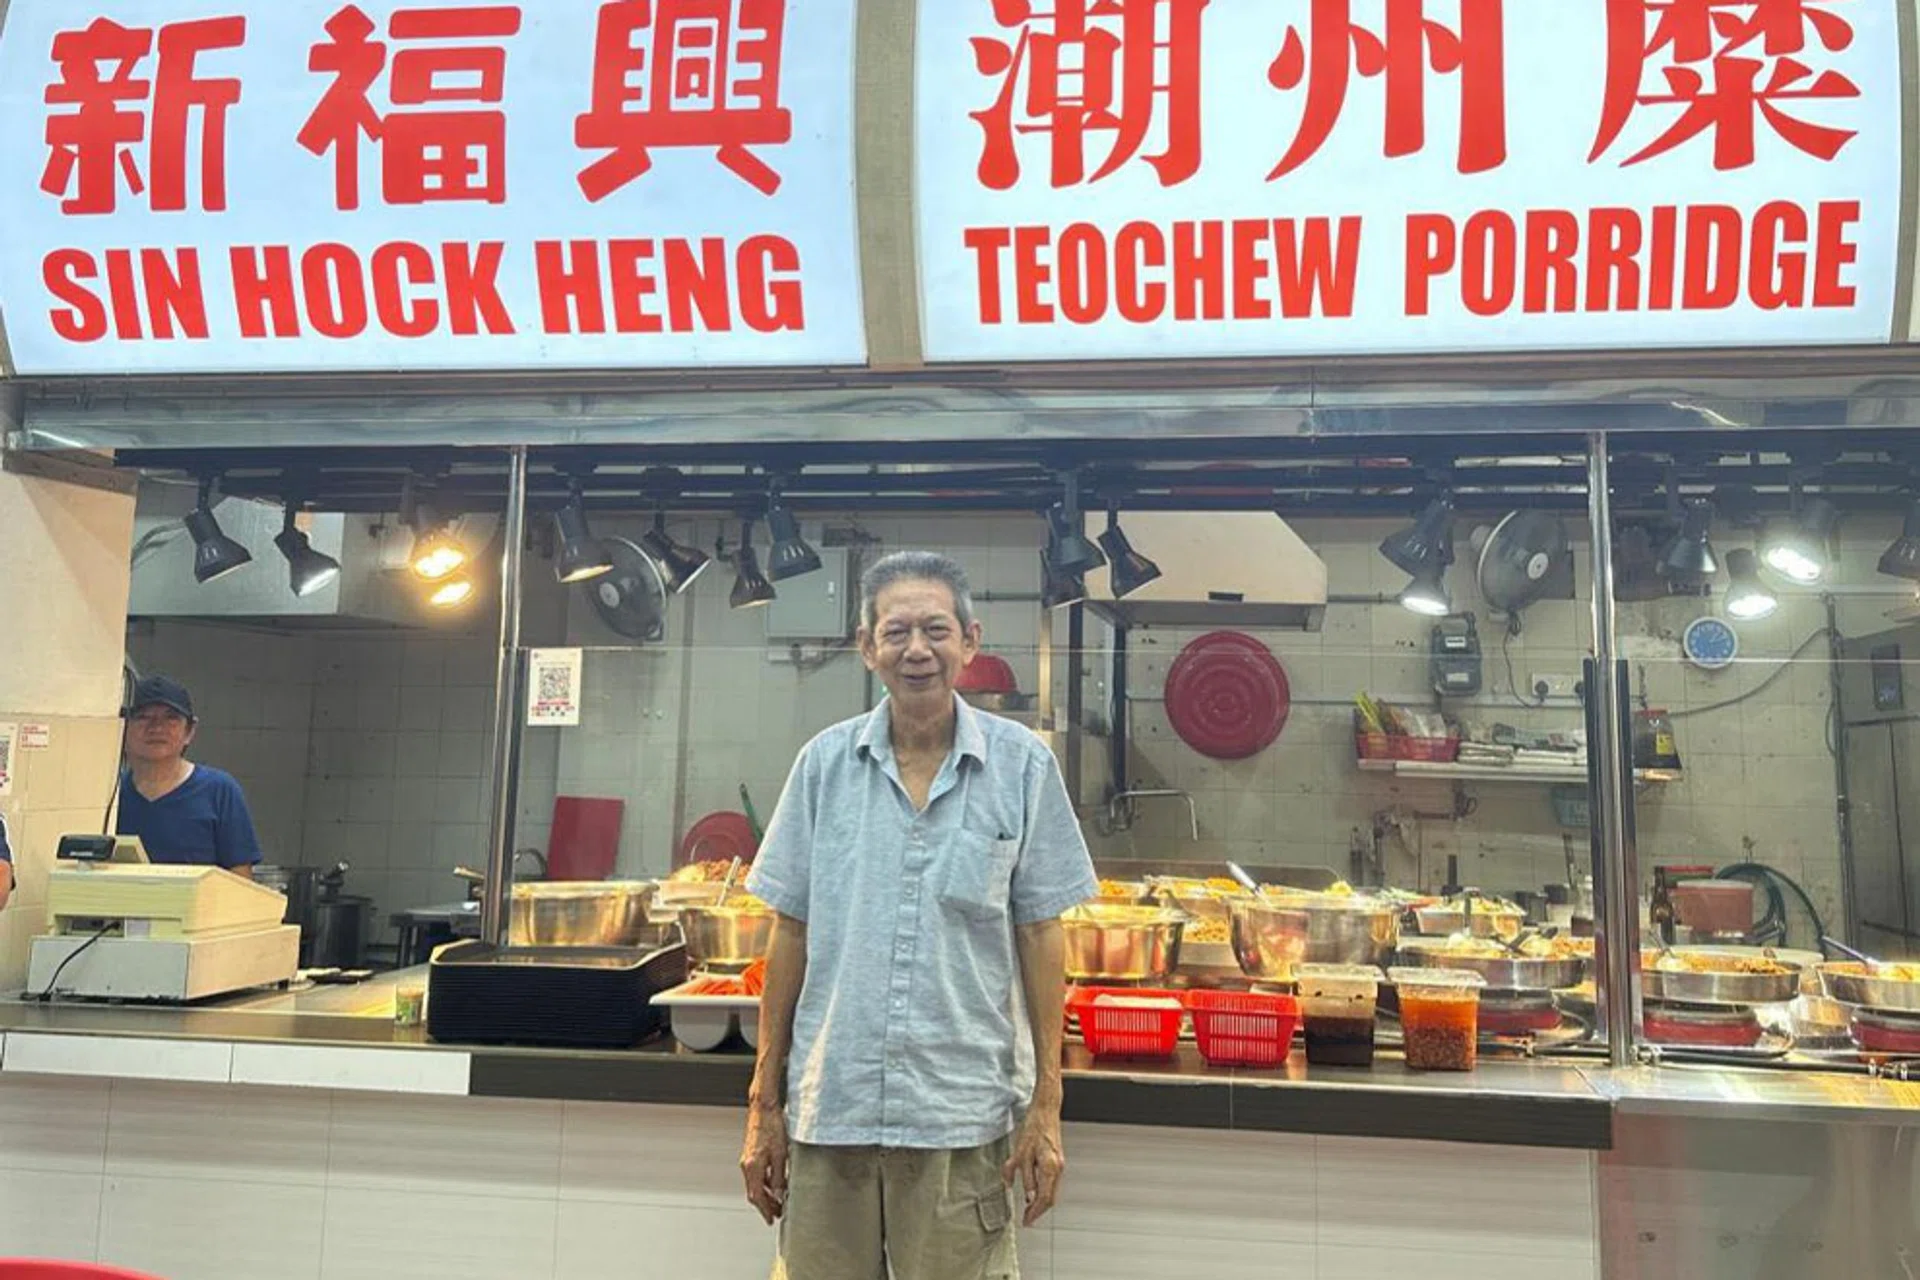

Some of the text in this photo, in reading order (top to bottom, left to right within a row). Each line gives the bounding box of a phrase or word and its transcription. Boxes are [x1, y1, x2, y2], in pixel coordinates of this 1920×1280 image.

[39, 0, 792, 216] 新福興
[42, 233, 804, 343] SIN HOCK HENG
[963, 199, 1861, 325] TEOCHEW PORRIDGE
